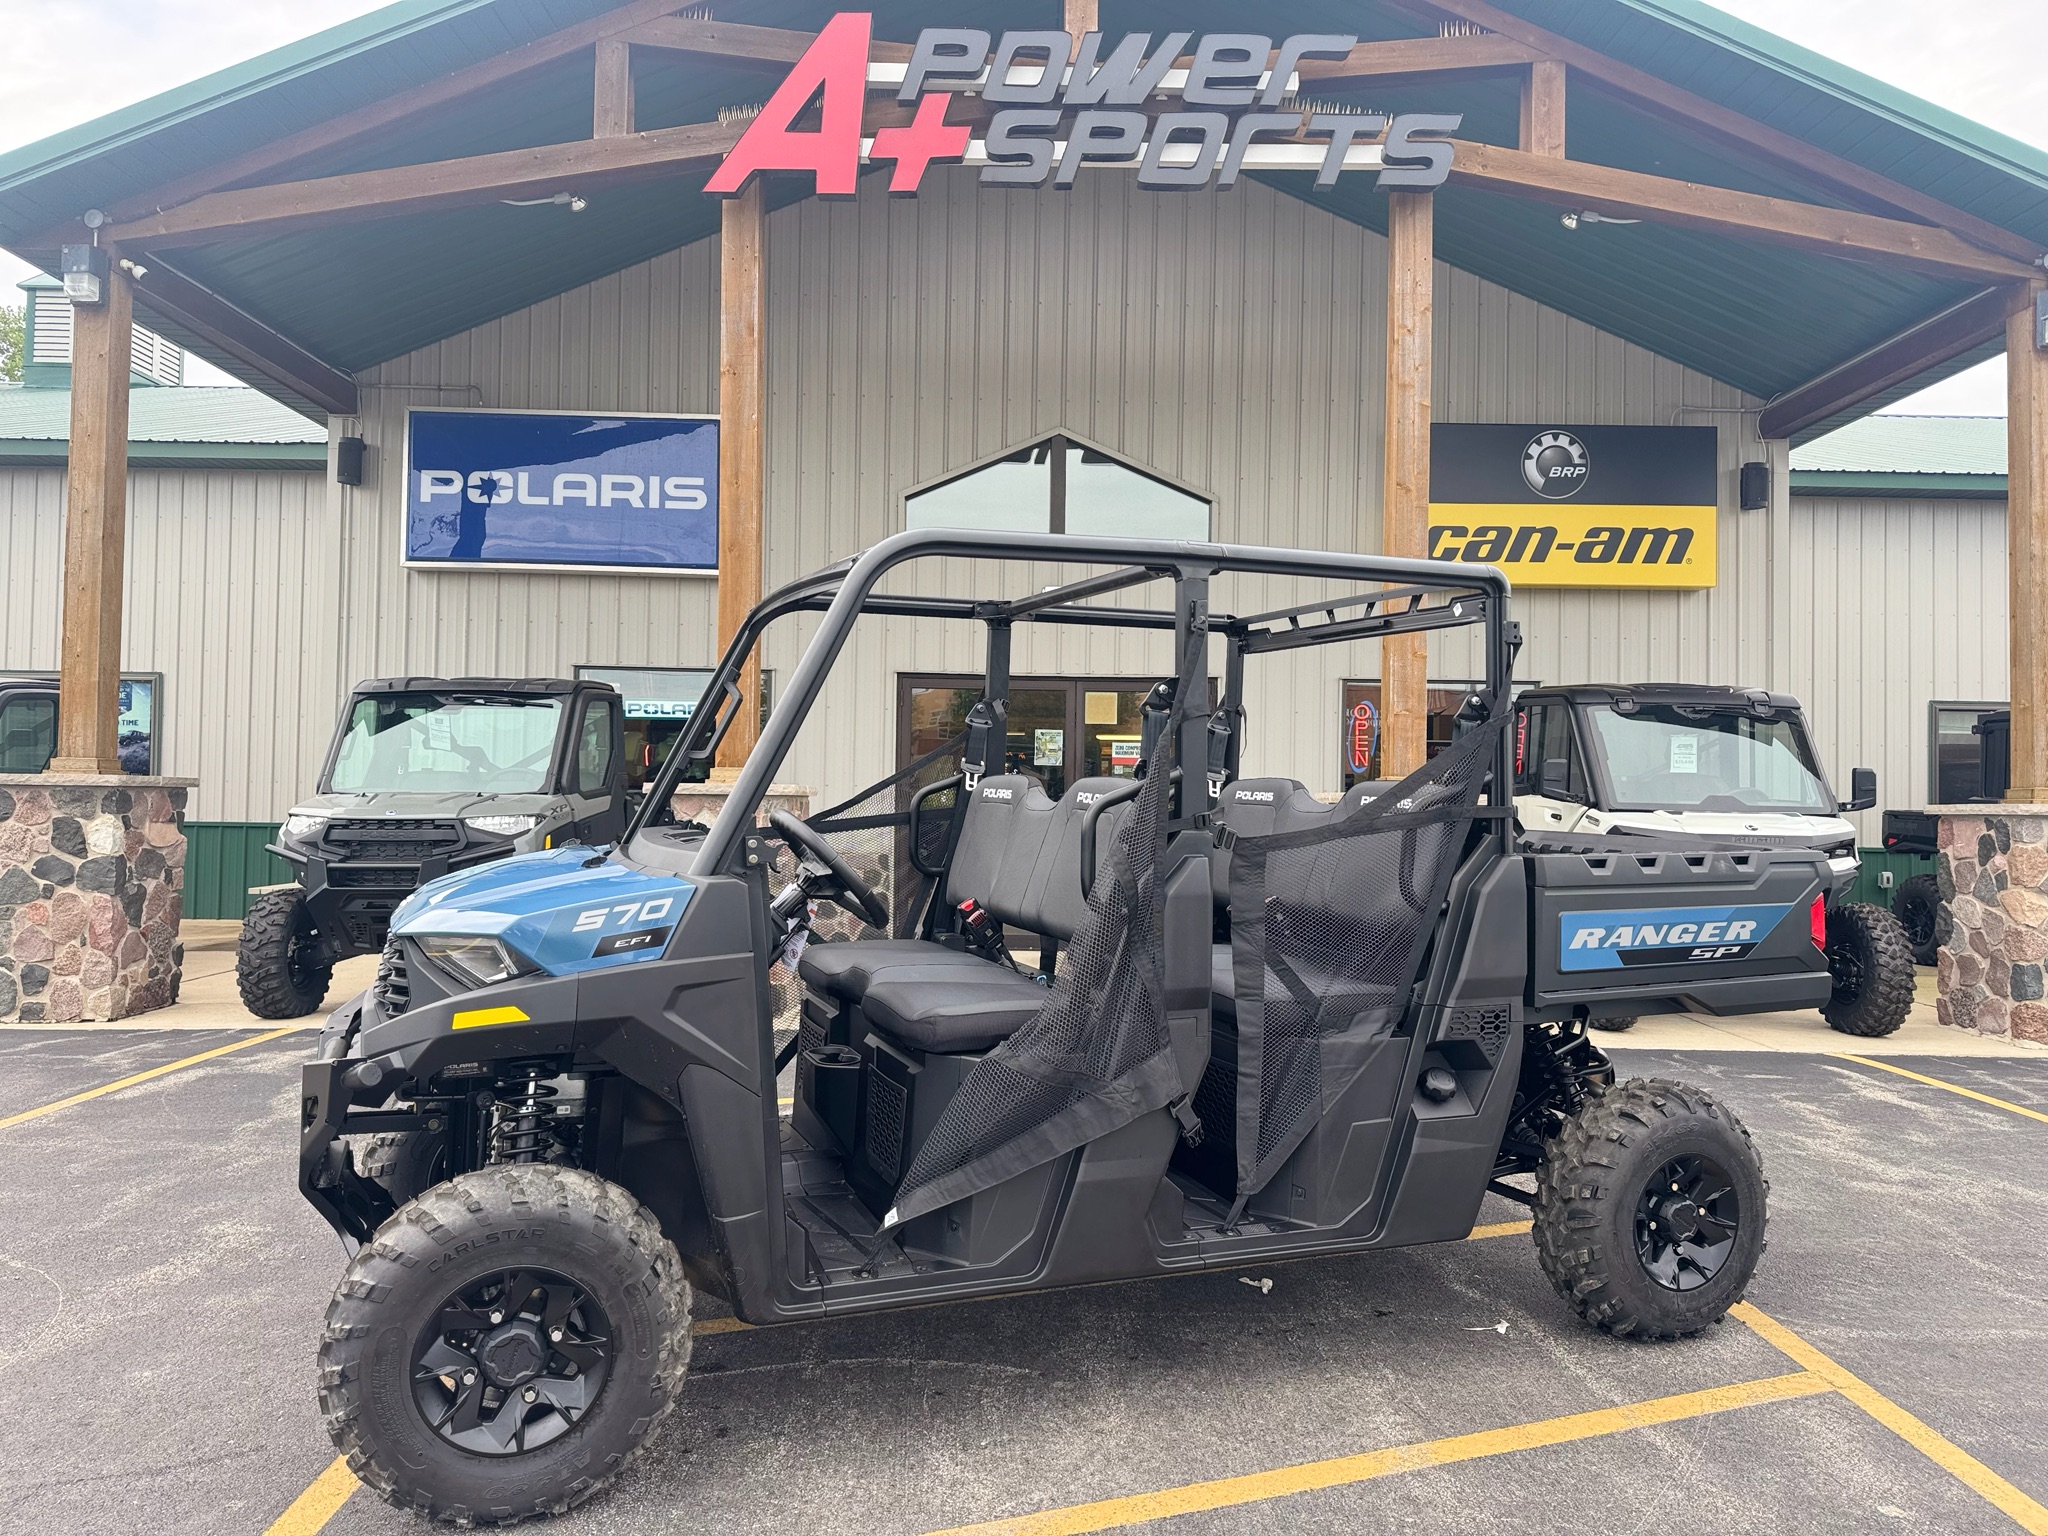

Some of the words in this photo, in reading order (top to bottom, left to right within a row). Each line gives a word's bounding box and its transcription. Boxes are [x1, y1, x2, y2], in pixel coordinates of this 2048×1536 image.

[1548, 466, 1586, 478] BRP
[419, 469, 708, 510] POLARIS
[1354, 704, 1370, 767] OPEN
[983, 788, 1012, 799] POLARIS
[1076, 792, 1103, 804] POLA
[1235, 790, 1273, 801] POLARIS
[550, 803, 568, 816] XP
[571, 897, 674, 933] 570
[614, 935, 652, 948] EFI
[1568, 920, 1757, 950] RANGER
[1688, 945, 1742, 960] SP
[426, 1227, 545, 1273] CARLSTAR
